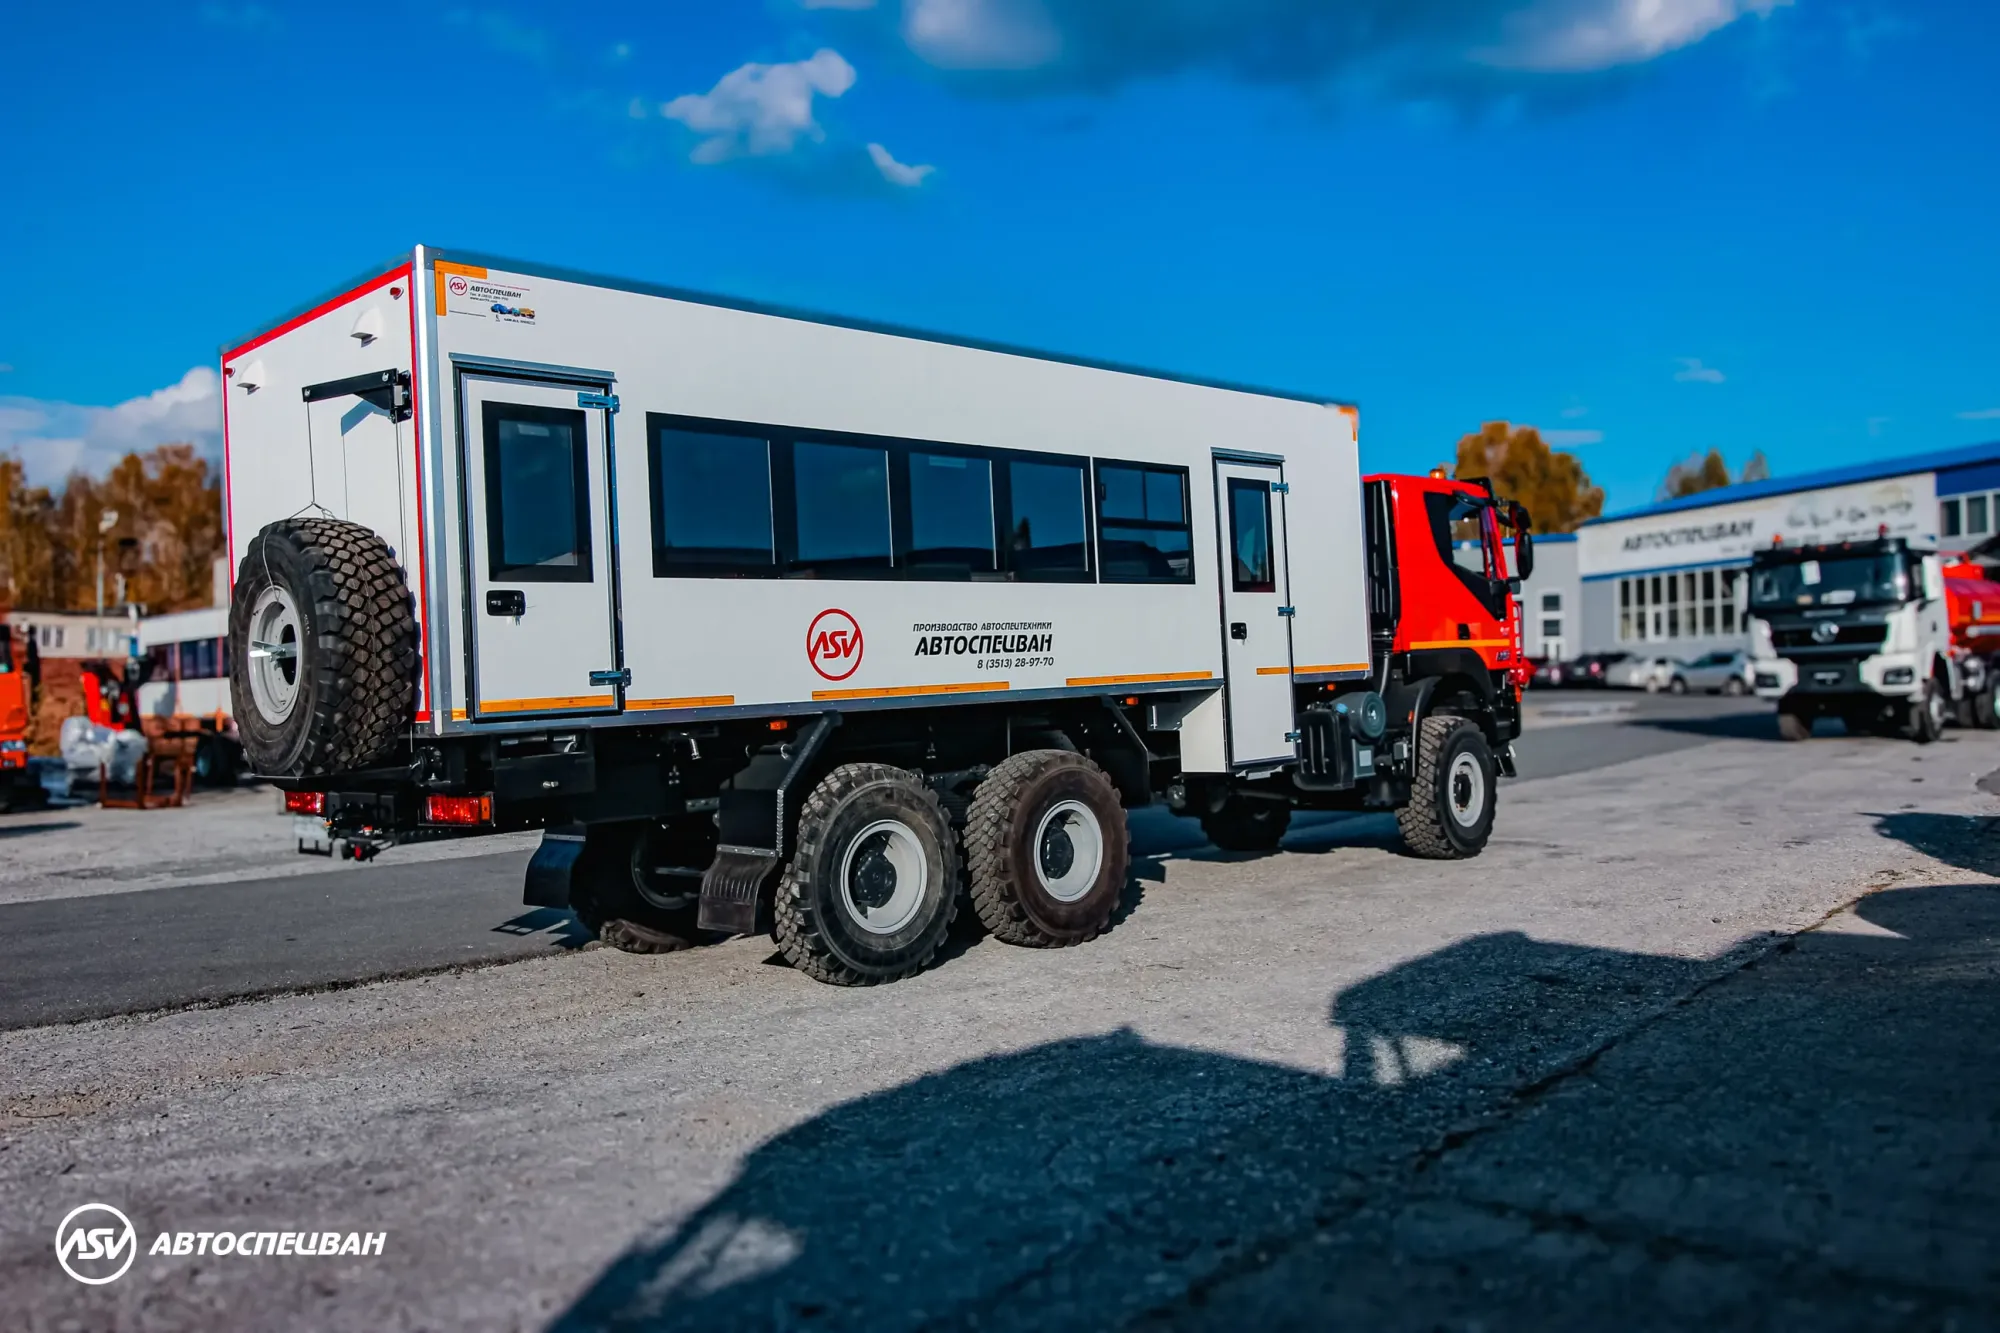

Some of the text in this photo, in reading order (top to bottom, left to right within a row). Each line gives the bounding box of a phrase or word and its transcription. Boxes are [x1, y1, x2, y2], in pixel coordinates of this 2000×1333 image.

[470, 285, 521, 298] АВТОСПЕЦВАН
[913, 621, 1052, 632] ПРОИЗВОДСТВО АВТОСПЕЦТЕХНИКИ
[914, 634, 1053, 656] АВТОСПЕЦВАН
[977, 657, 1054, 670] 8 (3513) 28-97-70
